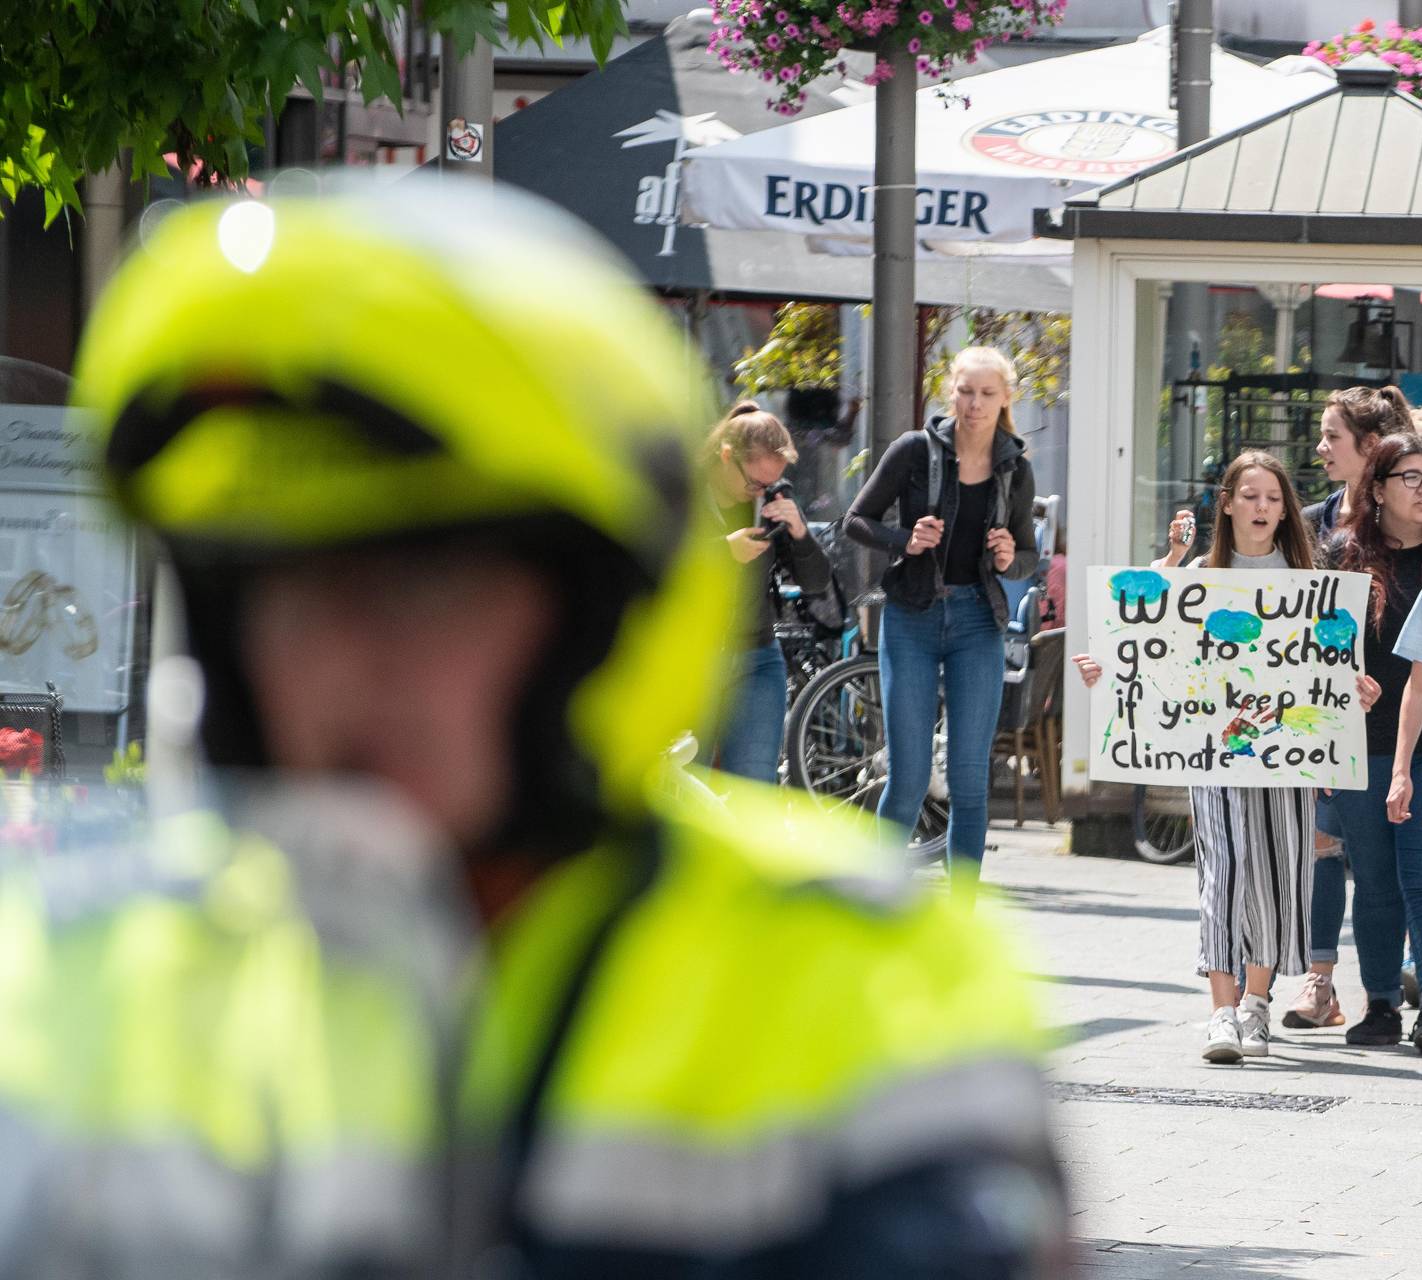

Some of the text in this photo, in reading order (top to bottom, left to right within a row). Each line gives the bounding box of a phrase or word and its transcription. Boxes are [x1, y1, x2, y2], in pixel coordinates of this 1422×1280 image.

[997, 111, 1178, 138] ERDING
[984, 144, 1138, 174] WEISSBR
[765, 174, 991, 235] ERDIGER
[1255, 575, 1342, 621] will
[1116, 627, 1360, 683] go to school
[1116, 677, 1351, 730] if you keep the
[1260, 740, 1340, 770] cool
